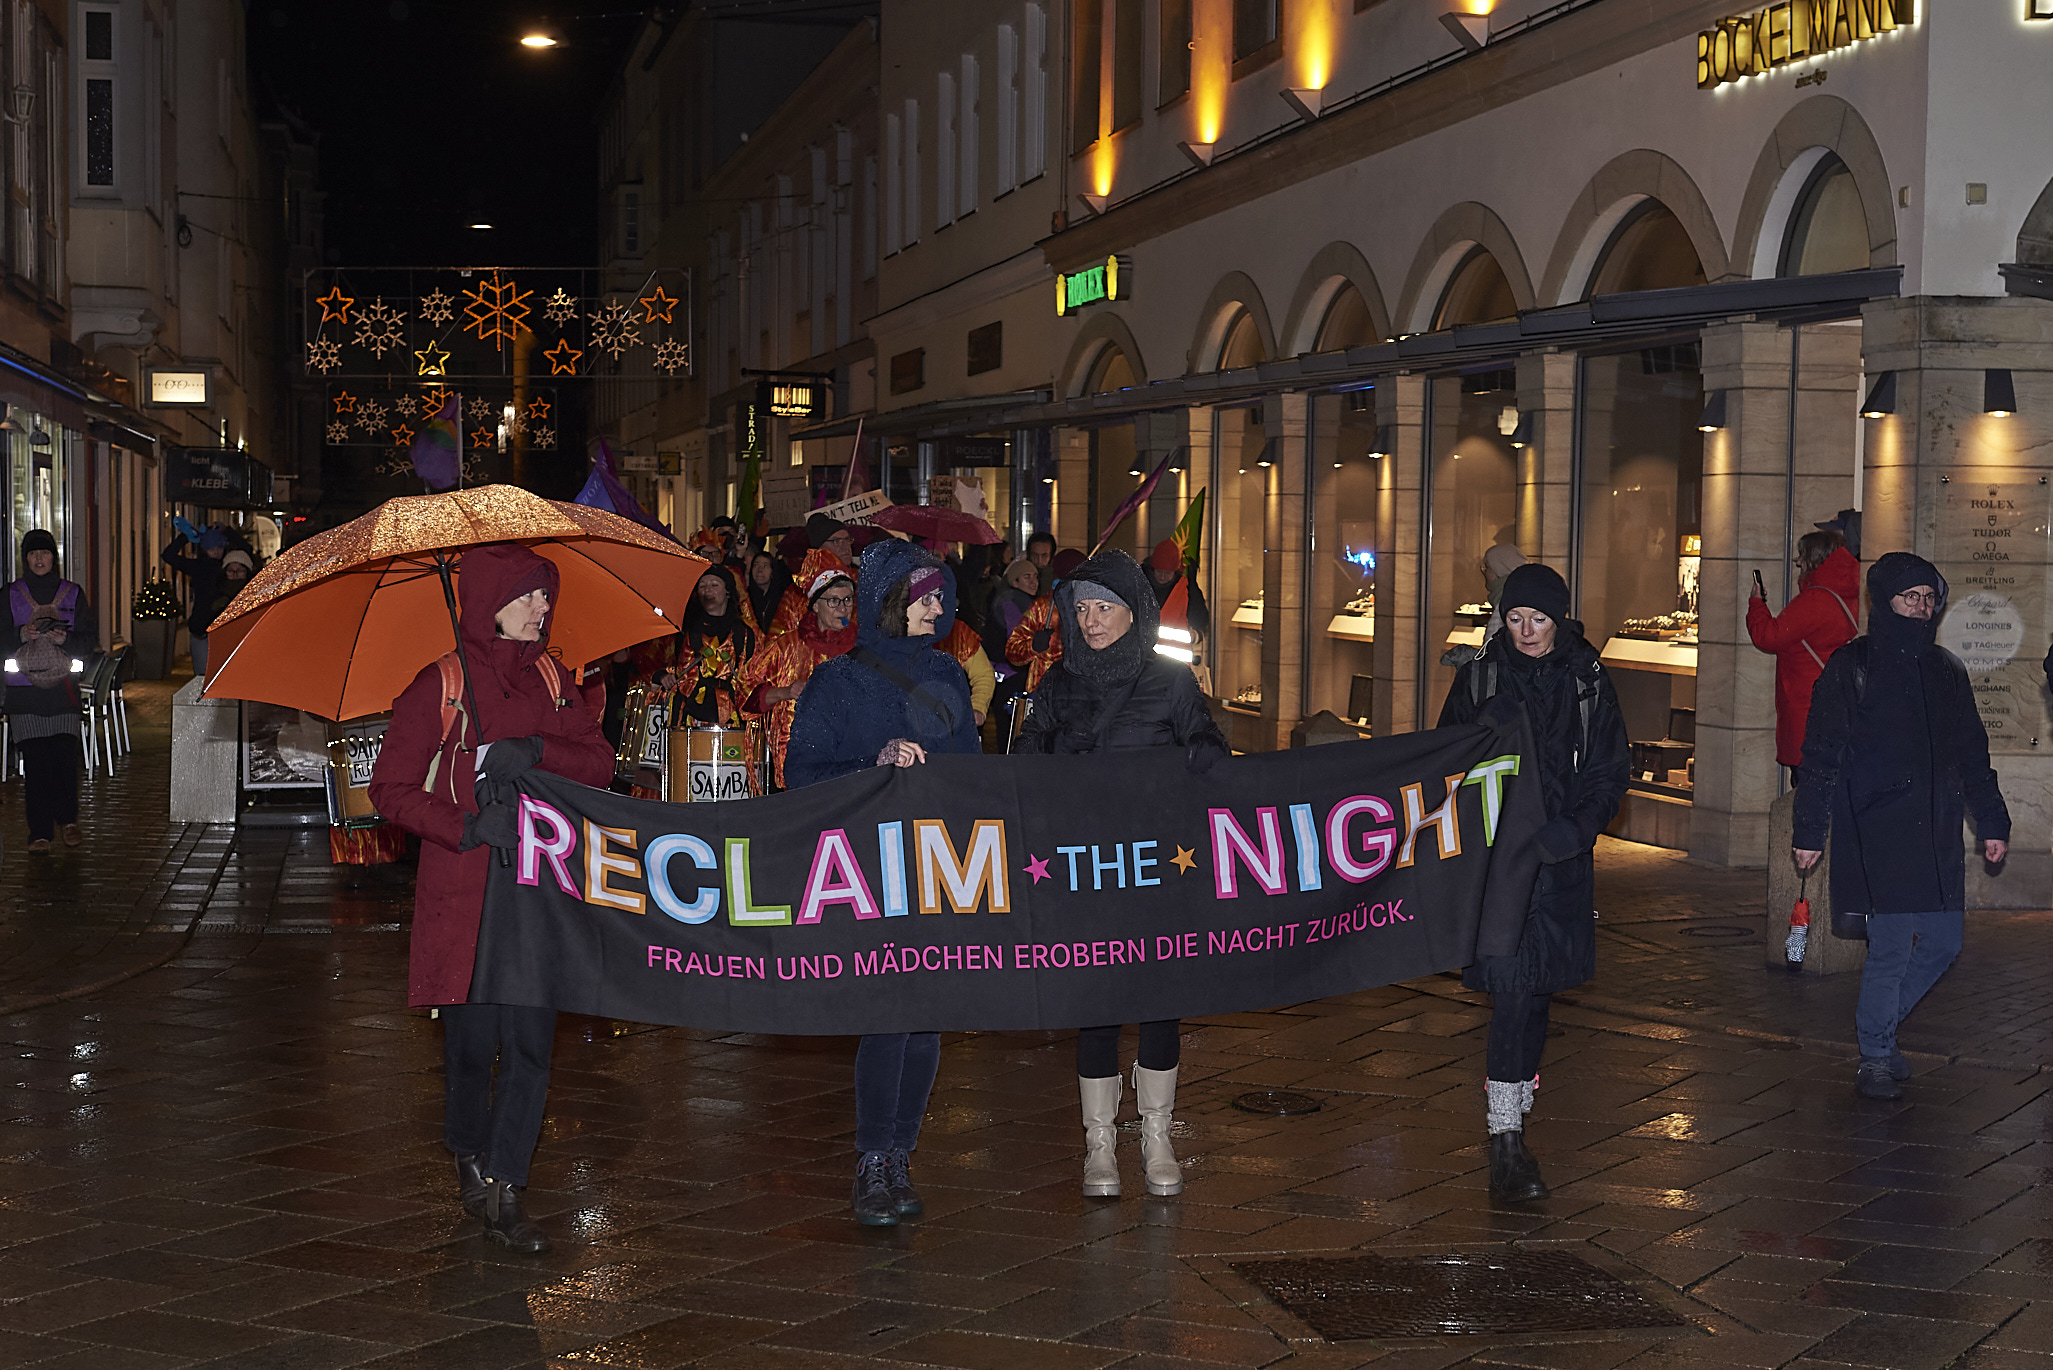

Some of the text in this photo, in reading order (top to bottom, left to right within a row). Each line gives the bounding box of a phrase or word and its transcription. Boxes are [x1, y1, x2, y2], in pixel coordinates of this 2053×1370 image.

[1066, 266, 1105, 307] ROLEX
[956, 446, 1000, 456] ROECKL
[191, 456, 210, 464] licht
[191, 478, 230, 489] KLEBE
[823, 506, 845, 519] ON'T
[848, 498, 869, 513] TELL
[1971, 499, 2015, 509] ROLEX
[1972, 529, 2011, 538] TUDOR
[1972, 552, 2010, 561] OMEGA
[1967, 594, 2013, 611] Chopard
[1966, 622, 2012, 630] LONGINES
[1963, 658, 2012, 666] NOMOS
[1972, 685, 2011, 693] NGHANS
[1983, 720, 2003, 728] IKO
[516, 754, 1520, 927] RECLAIM THE NIGHT
[647, 898, 1416, 980] FRAUEN UND MÄDCHEN EROBERN DIE NACHT ZURÜCK.
